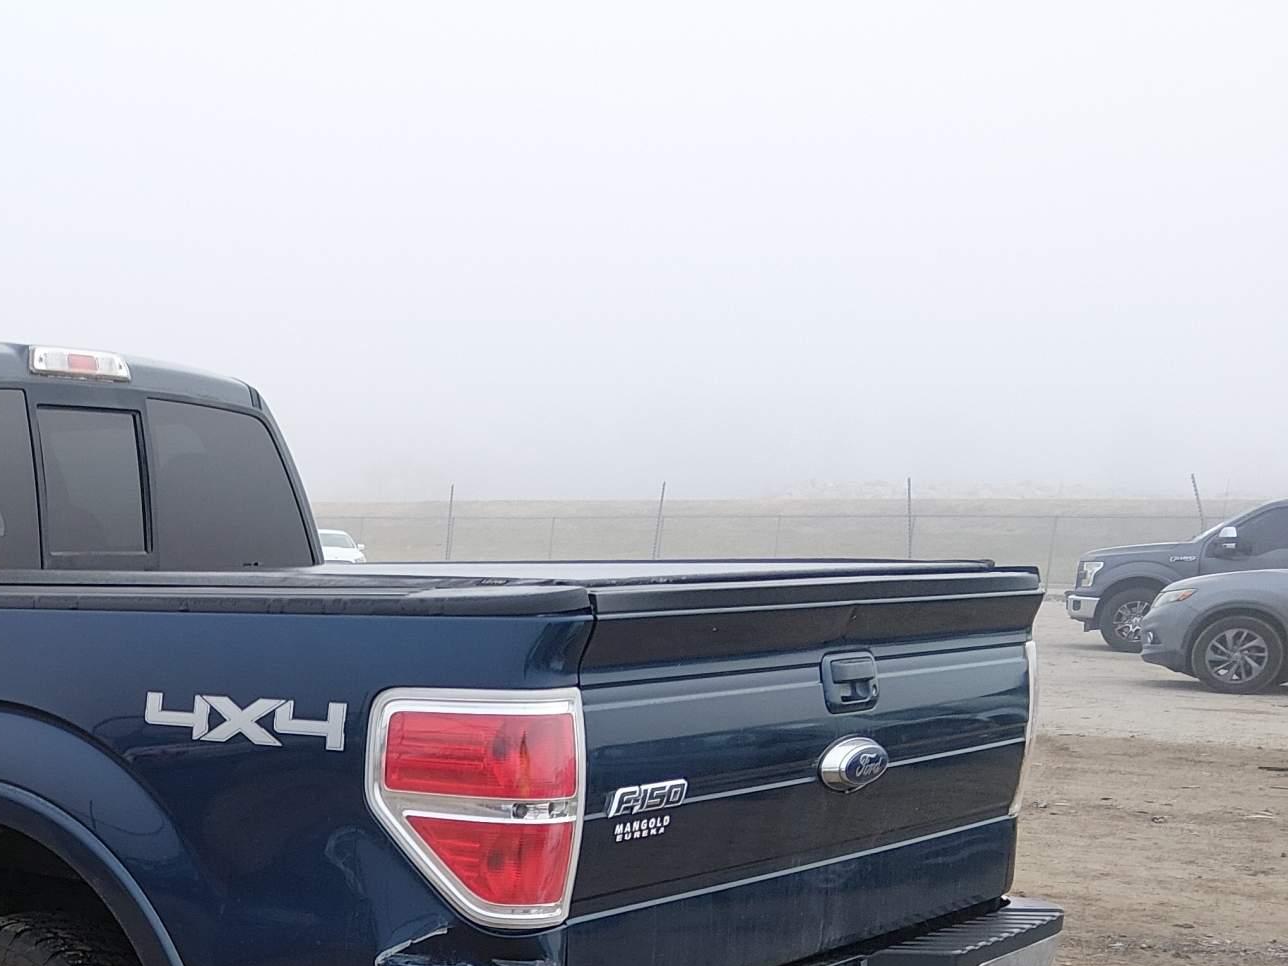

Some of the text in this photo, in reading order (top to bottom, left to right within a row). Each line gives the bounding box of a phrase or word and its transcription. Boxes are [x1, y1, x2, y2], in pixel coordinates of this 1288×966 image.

[144, 691, 348, 751] 4X4
[855, 752, 883, 777] Ford
[614, 815, 671, 835] MANGOLD
[615, 826, 666, 842] EUREKA
